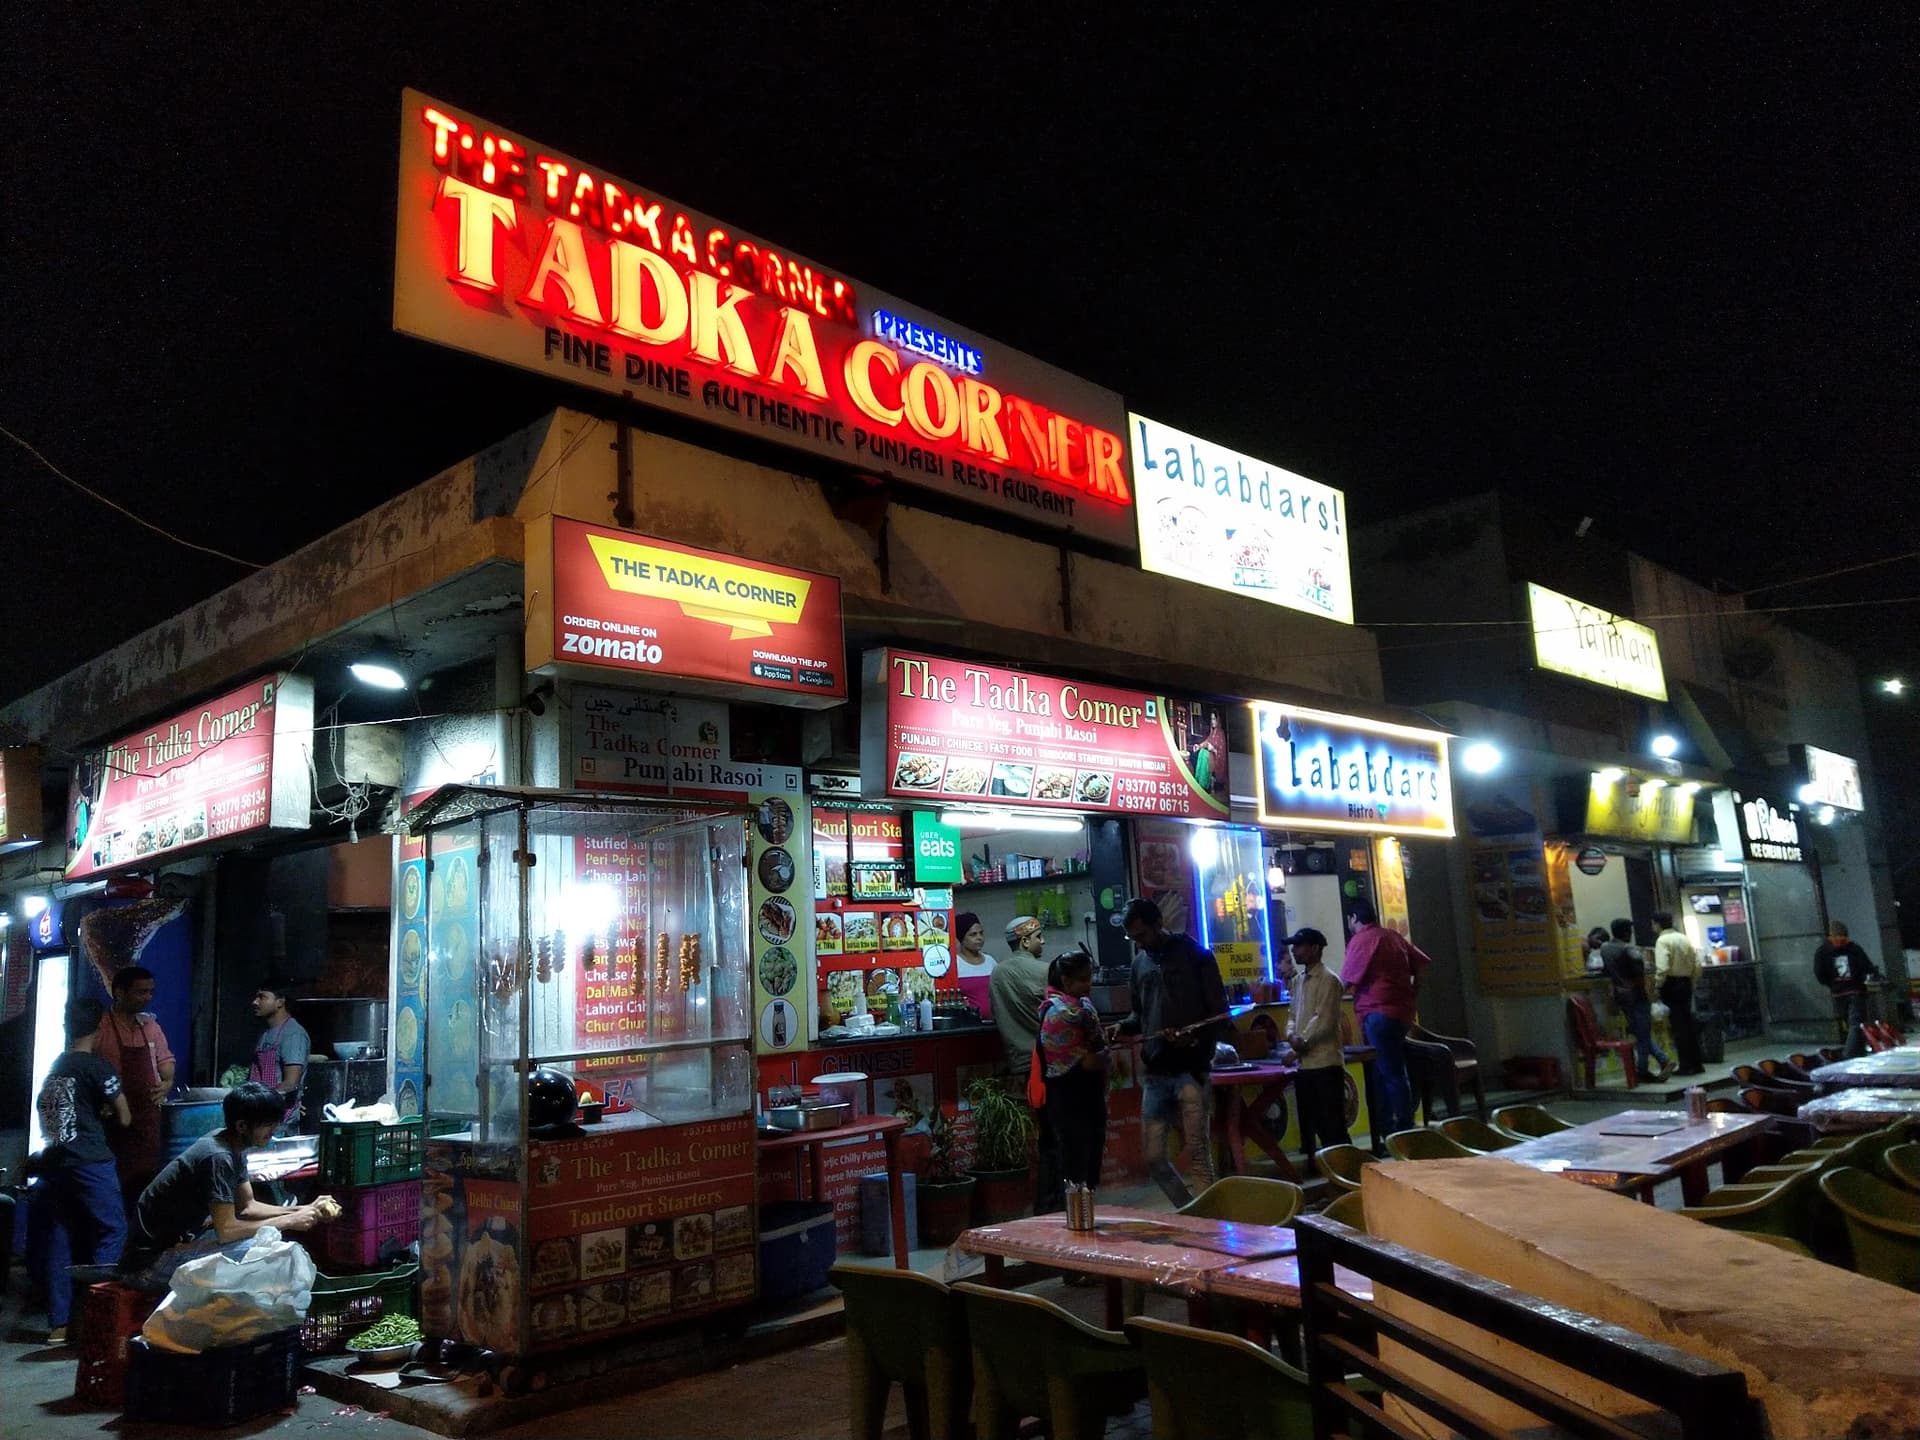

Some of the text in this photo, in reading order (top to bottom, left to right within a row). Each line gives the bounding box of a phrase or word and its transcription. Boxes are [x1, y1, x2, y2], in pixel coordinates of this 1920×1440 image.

[423, 104, 858, 330] THE TADKA CORNER
[437, 173, 1133, 506] TADKA CORNER
[873, 306, 985, 375] PRESENTS
[543, 325, 1078, 520] FINE DINE AUTHENTIC PUNJABI RESTAURANT
[610, 555, 798, 609] THE TADKA CORNER
[563, 614, 657, 638] ORDER ONLINE ON
[562, 631, 663, 664] zomato
[752, 650, 828, 669] DOWNLOAD THE APP
[763, 670, 791, 682] App Store
[893, 656, 1142, 730] The Tadka Corner
[585, 713, 620, 732] The
[1015, 718, 1062, 740] Punjabi
[1064, 724, 1098, 744] Rasoi
[112, 744, 140, 783] The
[143, 723, 193, 770] Tadka
[197, 701, 260, 749] Corner
[585, 730, 721, 760] Tadka Corner
[901, 732, 940, 747] PUNJABI
[991, 743, 1009, 755] FAST
[1011, 746, 1033, 757] FOOD
[623, 757, 764, 787] Punabi Rasoi
[1126, 779, 1189, 797] 93770 56134
[1126, 796, 1190, 813] 93747 06715
[1348, 803, 1374, 819] Bistro
[881, 819, 903, 838] Sta
[584, 836, 628, 850] Stuffed
[920, 837, 955, 858] eats
[585, 852, 608, 865] Peri
[612, 854, 634, 866] Peri
[585, 969, 628, 983] Chese
[586, 985, 606, 999] Dal
[585, 1001, 623, 1016] Lahori
[585, 1020, 614, 1033] Chur
[617, 1017, 646, 1030] Chur
[584, 1033, 648, 1050] Spiral Stic
[822, 1048, 914, 1076] CHINESE
[570, 1139, 751, 1180] The Tadka Corner
[641, 1173, 675, 1187] Punjabi
[676, 1168, 701, 1181] Rasoi
[568, 1190, 722, 1229] Tandoori Starters
